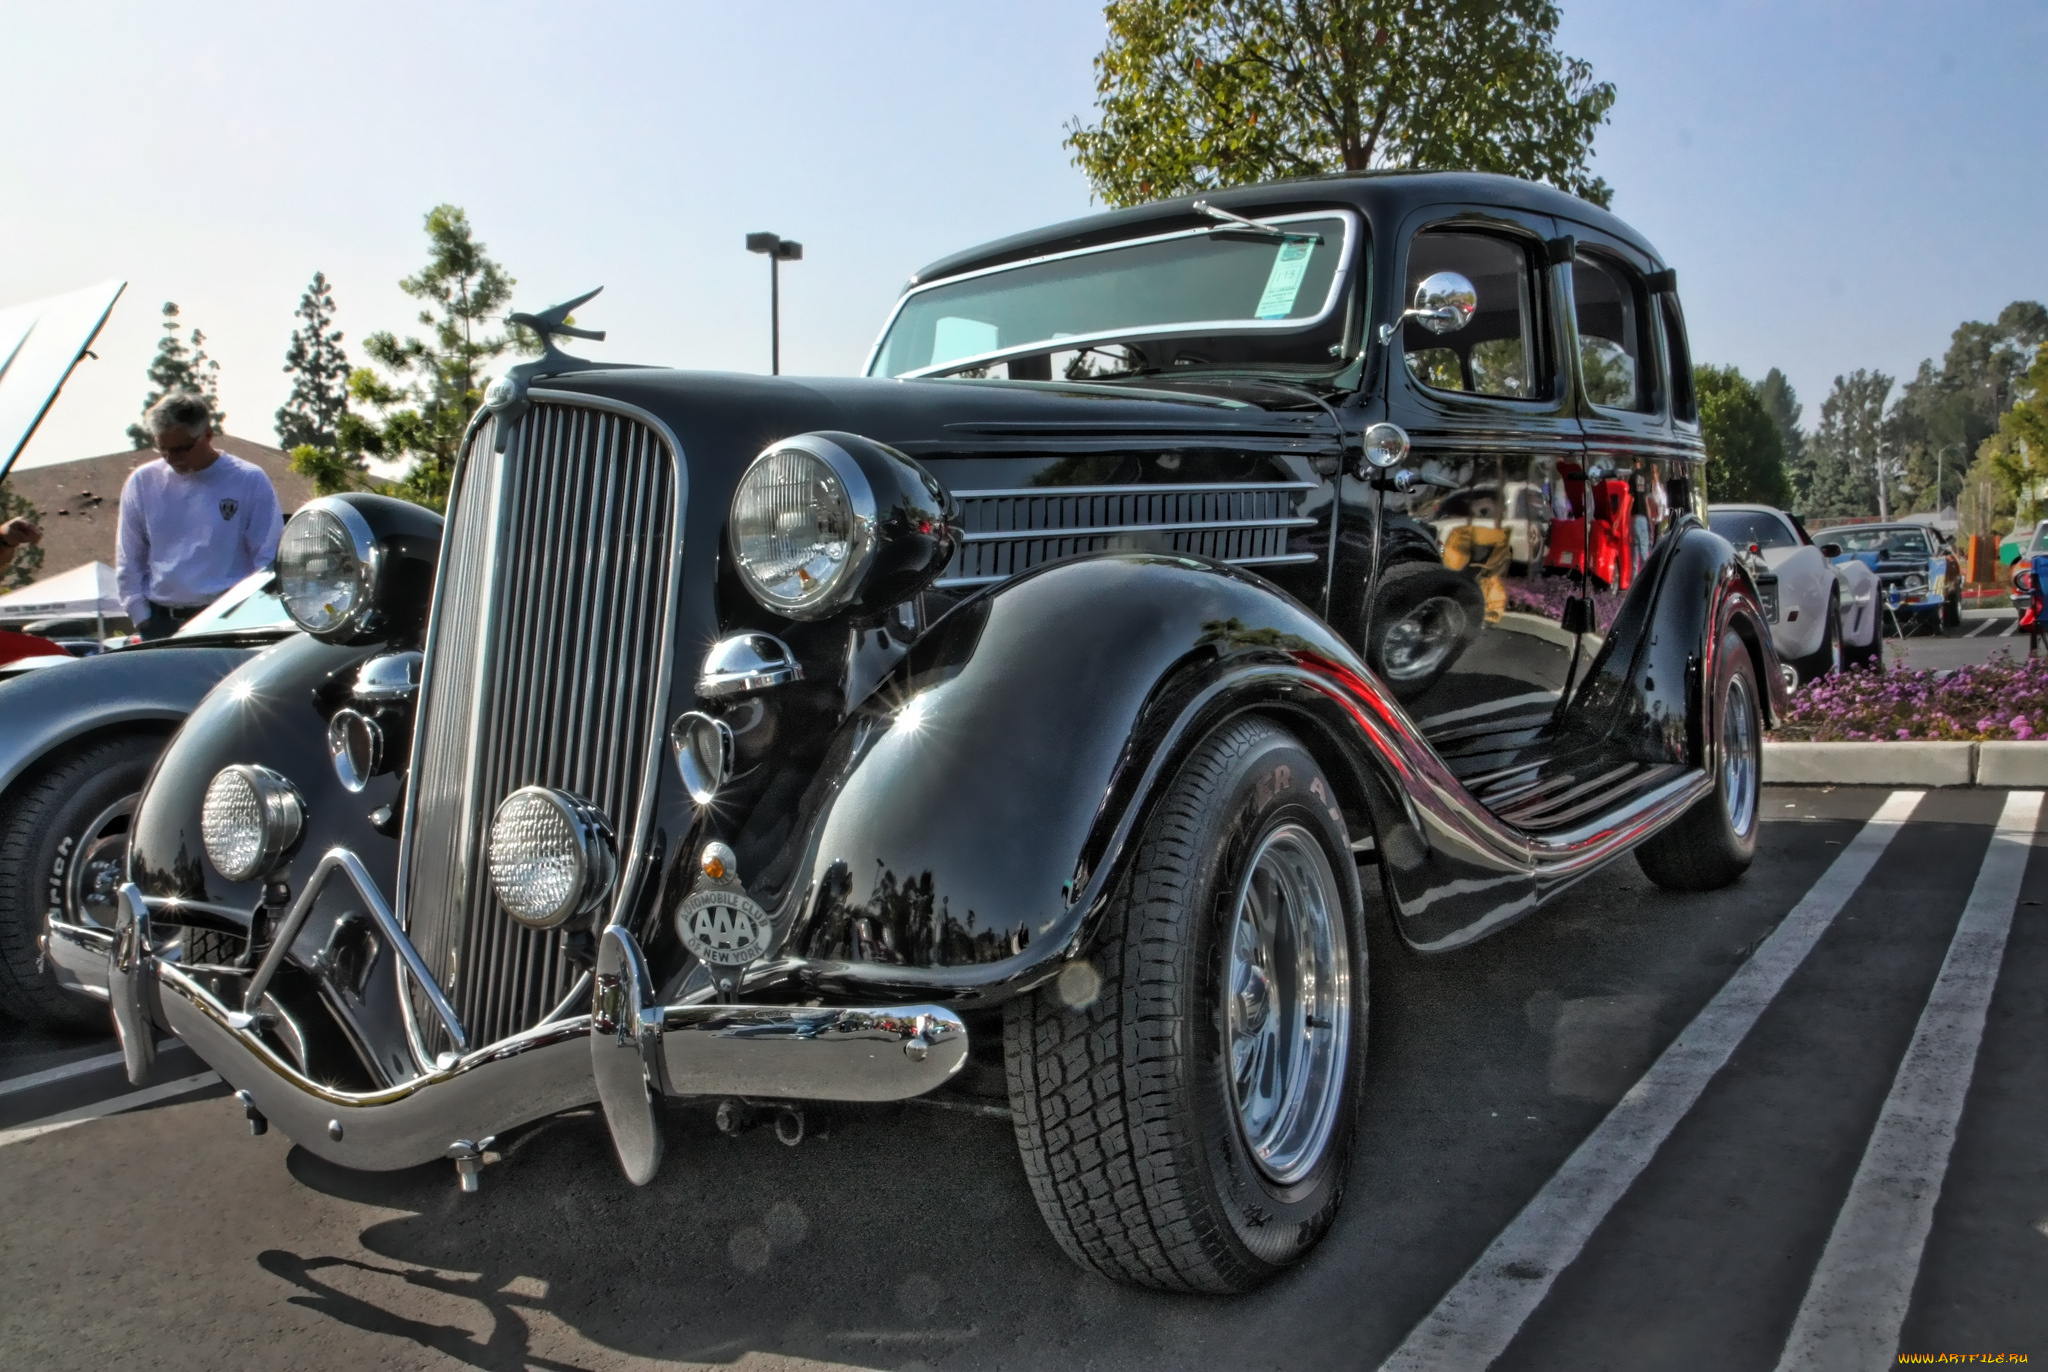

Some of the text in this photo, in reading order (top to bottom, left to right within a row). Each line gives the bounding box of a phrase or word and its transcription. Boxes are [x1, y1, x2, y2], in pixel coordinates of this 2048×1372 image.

[680, 893, 768, 927] AUTOMOBILE CLUB
[694, 907, 756, 949] AAA
[688, 938, 763, 962] OF NEW YORK
